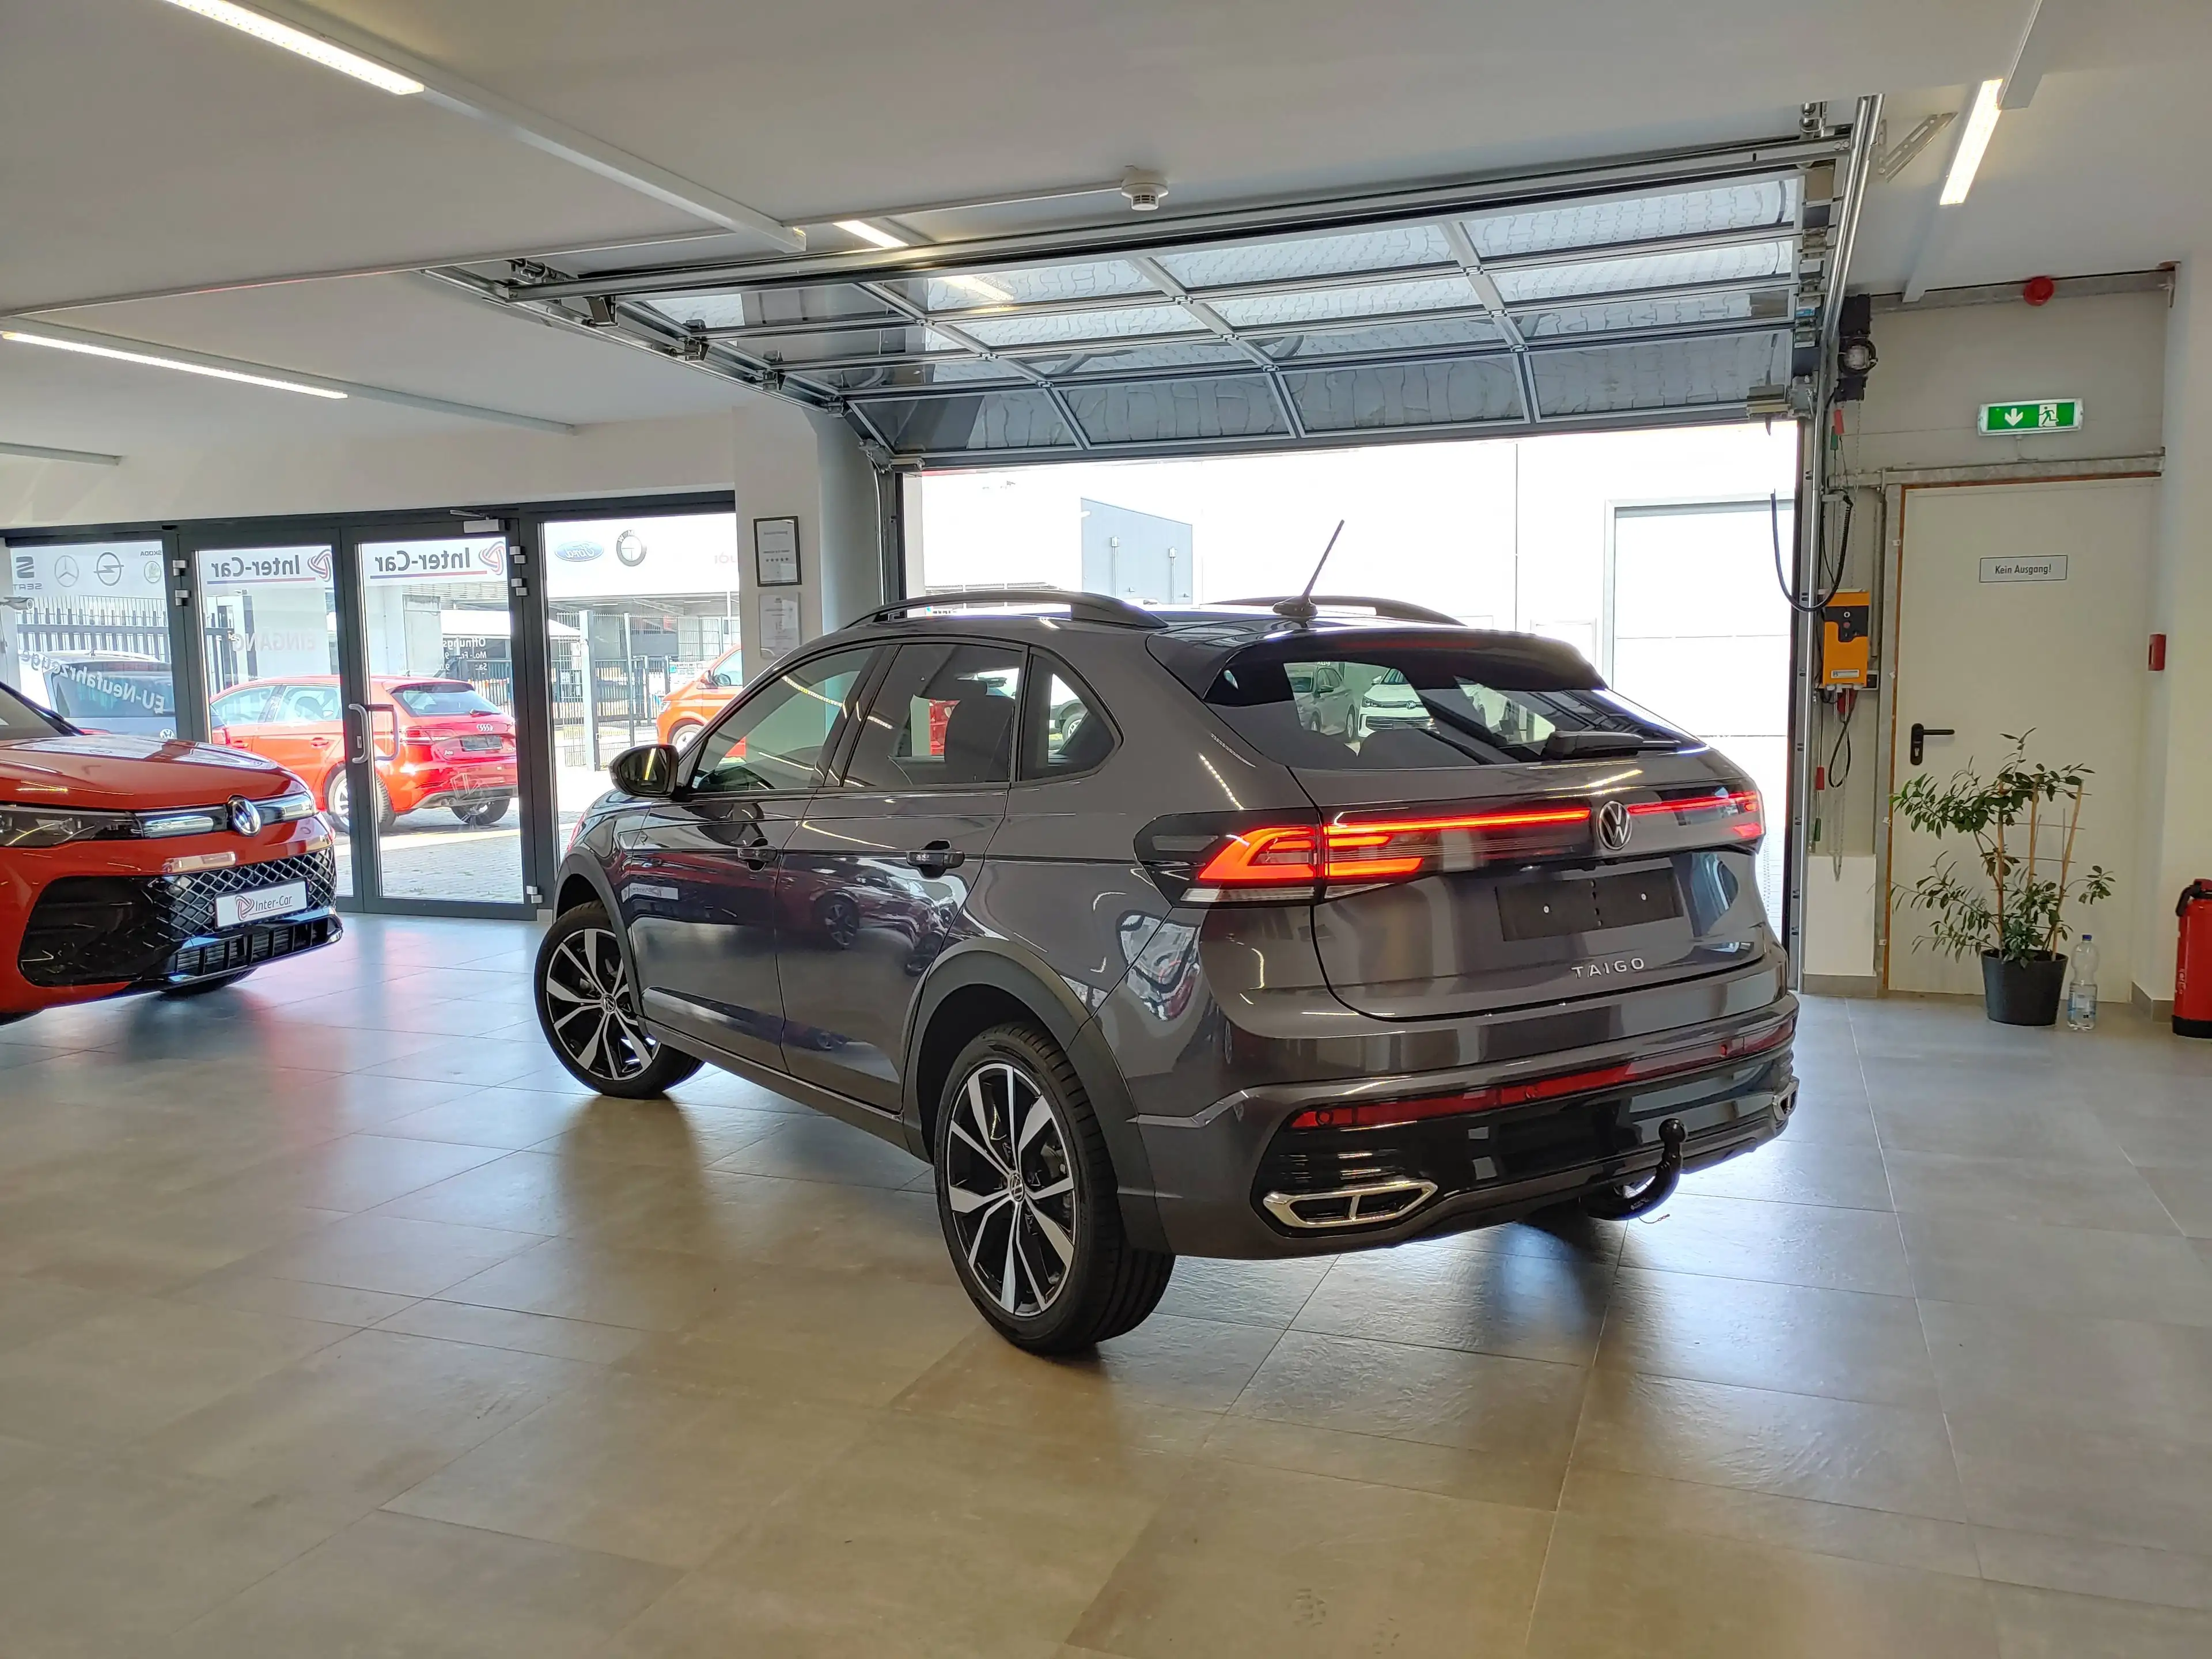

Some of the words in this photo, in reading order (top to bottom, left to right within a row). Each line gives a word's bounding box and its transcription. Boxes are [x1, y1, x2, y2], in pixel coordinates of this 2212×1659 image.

[1994, 565, 2013, 574] Kein
[2014, 563, 2052, 575] Ausgang!
[255, 895, 293, 912] Inter-Car
[1571, 957, 1645, 979] TAIGO
